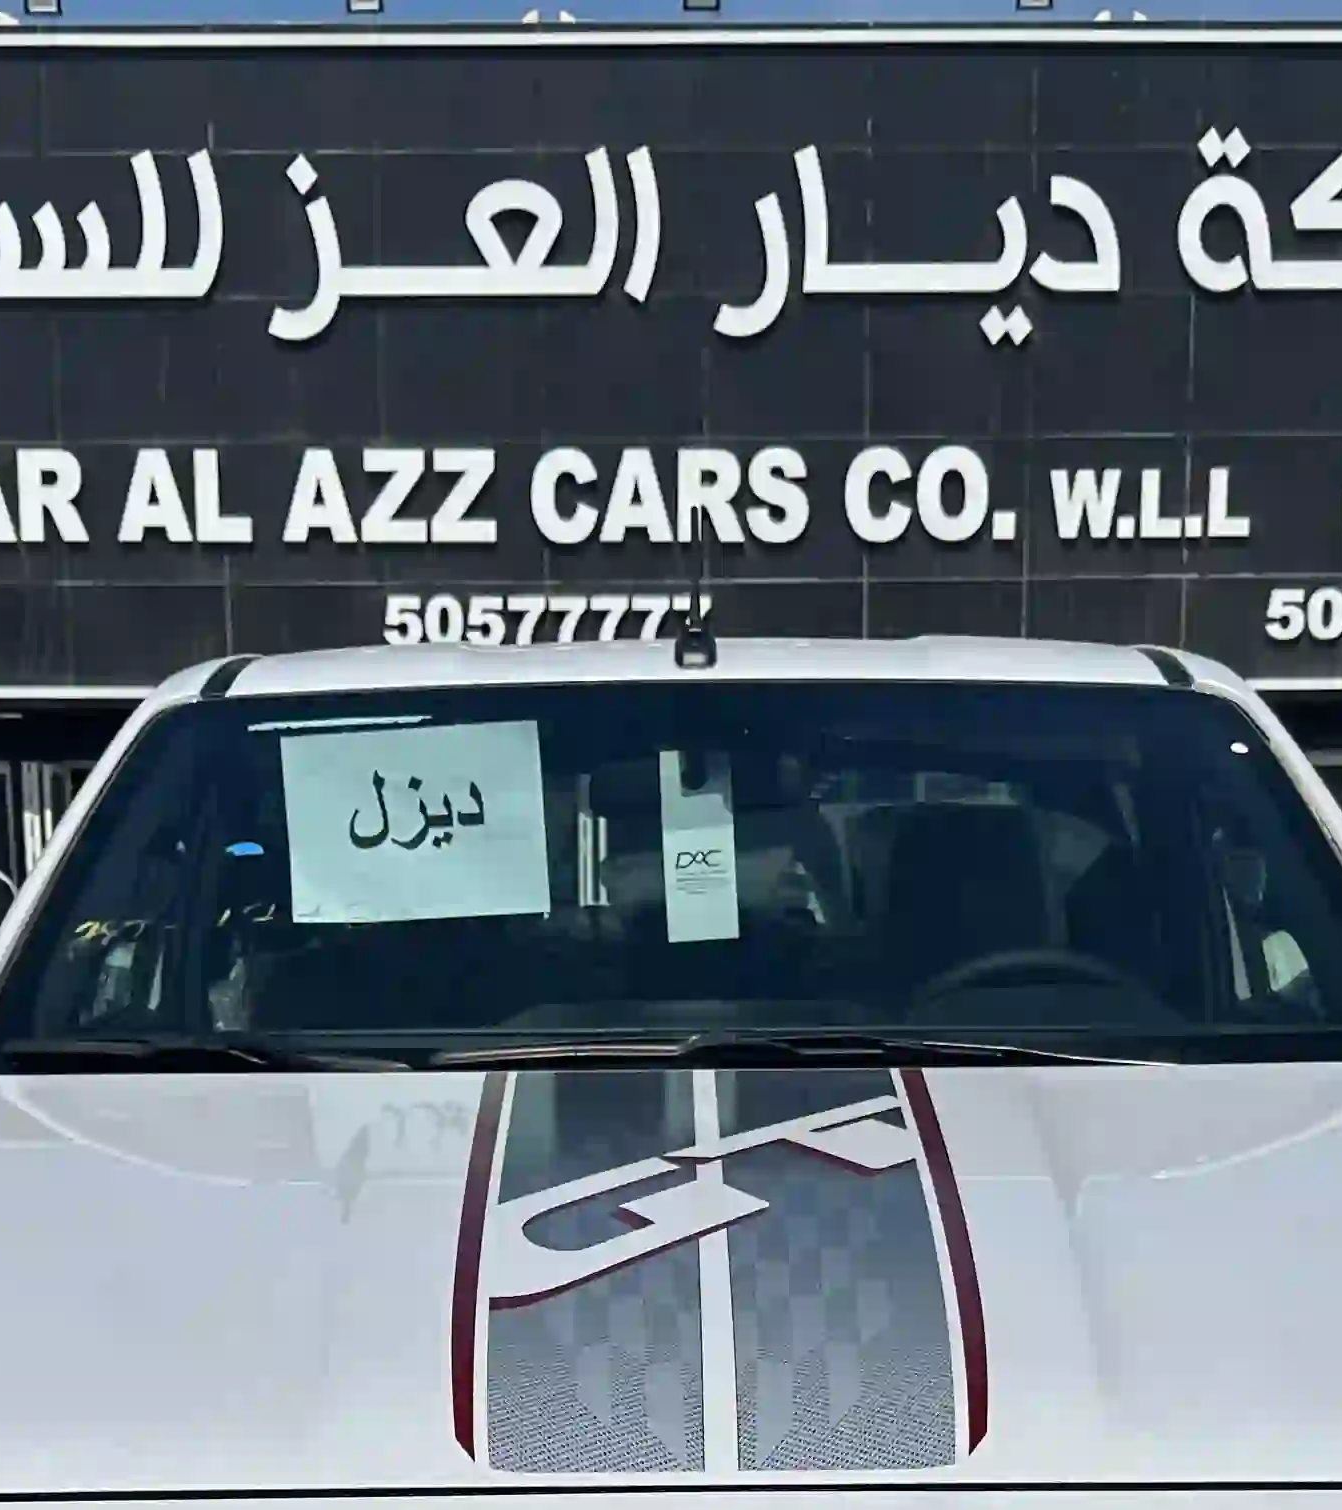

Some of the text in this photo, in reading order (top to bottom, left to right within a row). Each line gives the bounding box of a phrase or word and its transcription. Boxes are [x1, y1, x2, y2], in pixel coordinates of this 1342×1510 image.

[267, 144, 662, 341] العز
[713, 144, 1121, 346] ديار
[117, 447, 254, 545] AL
[282, 447, 499, 545] AZZ
[530, 446, 811, 545] CARS
[843, 444, 1017, 544] CO.
[1049, 467, 1251, 540] W.L.L
[348, 768, 486, 852] ديزل
